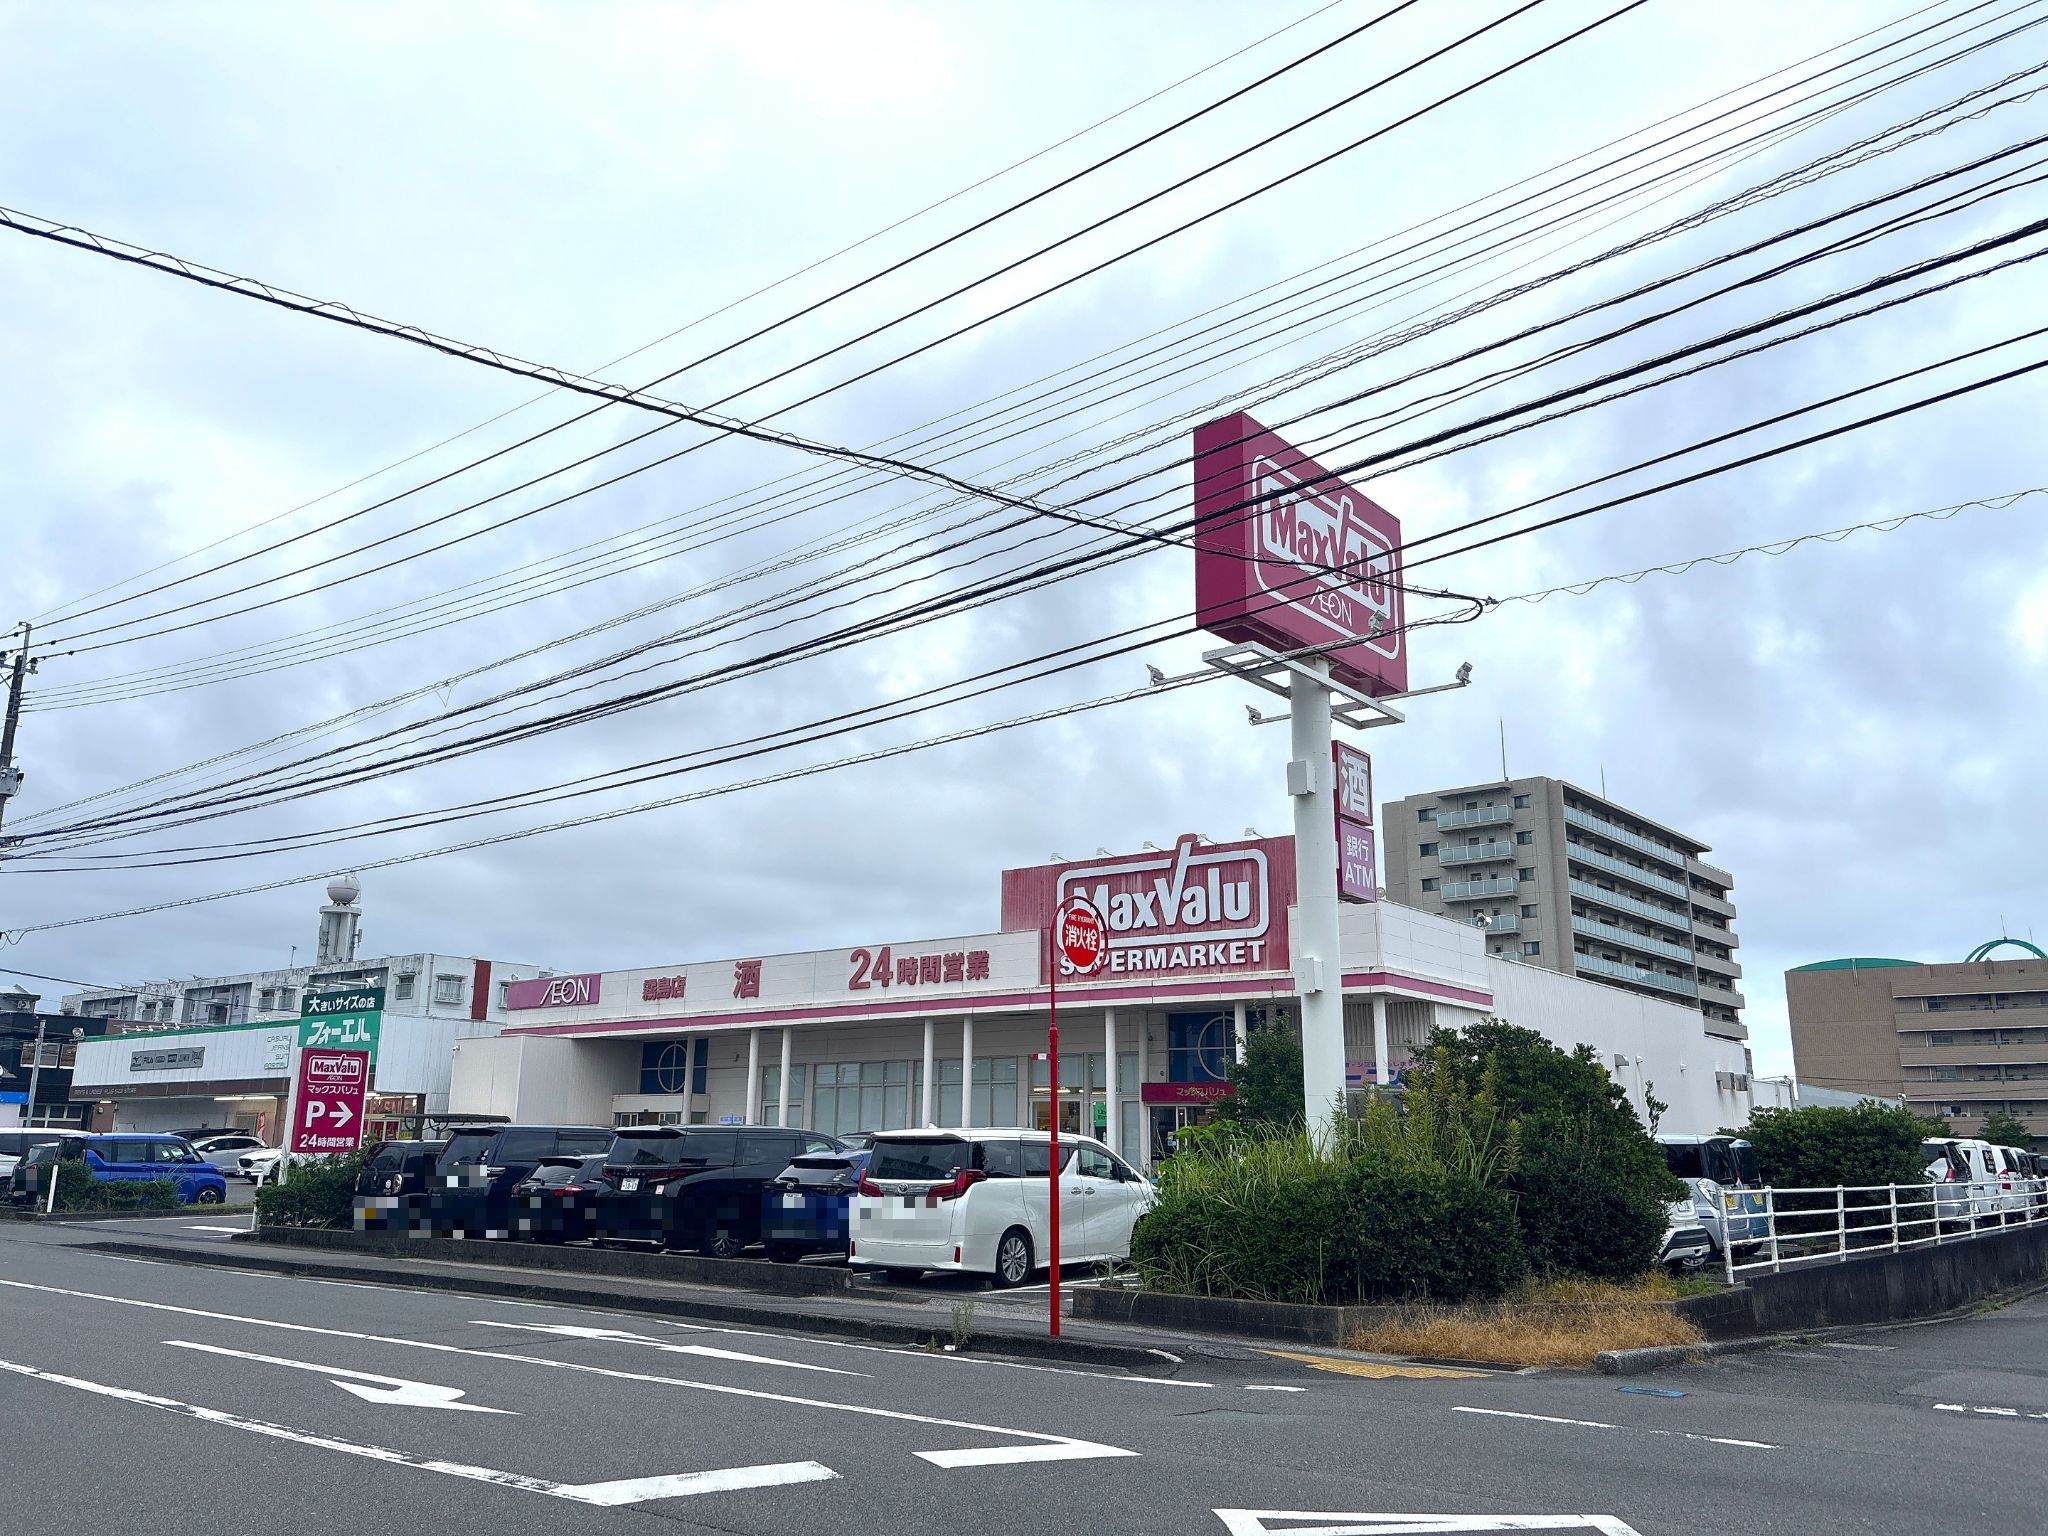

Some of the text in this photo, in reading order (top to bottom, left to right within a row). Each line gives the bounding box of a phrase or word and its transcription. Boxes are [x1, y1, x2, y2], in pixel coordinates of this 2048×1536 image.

[1270, 490, 1385, 607] MaxValu
[1341, 751, 1369, 817] 酒
[1346, 835, 1369, 862] 銀行
[1073, 842, 1251, 932] MaxValu
[1345, 862, 1374, 890] ATM
[1065, 924, 1098, 952] 消火栓
[849, 947, 990, 990] 24時間営業
[1060, 940, 1265, 975] SPERMARKET
[642, 975, 687, 1001] 霧島店
[733, 960, 762, 998] 酒
[308, 995, 375, 1013] 大きいサイズの店
[306, 1018, 371, 1045] フォーエル
[313, 1054, 358, 1074] MaxValu
[307, 1085, 359, 1095] マックスバリュ
[305, 1101, 326, 1128] P
[300, 1134, 355, 1148] 24時間営業
